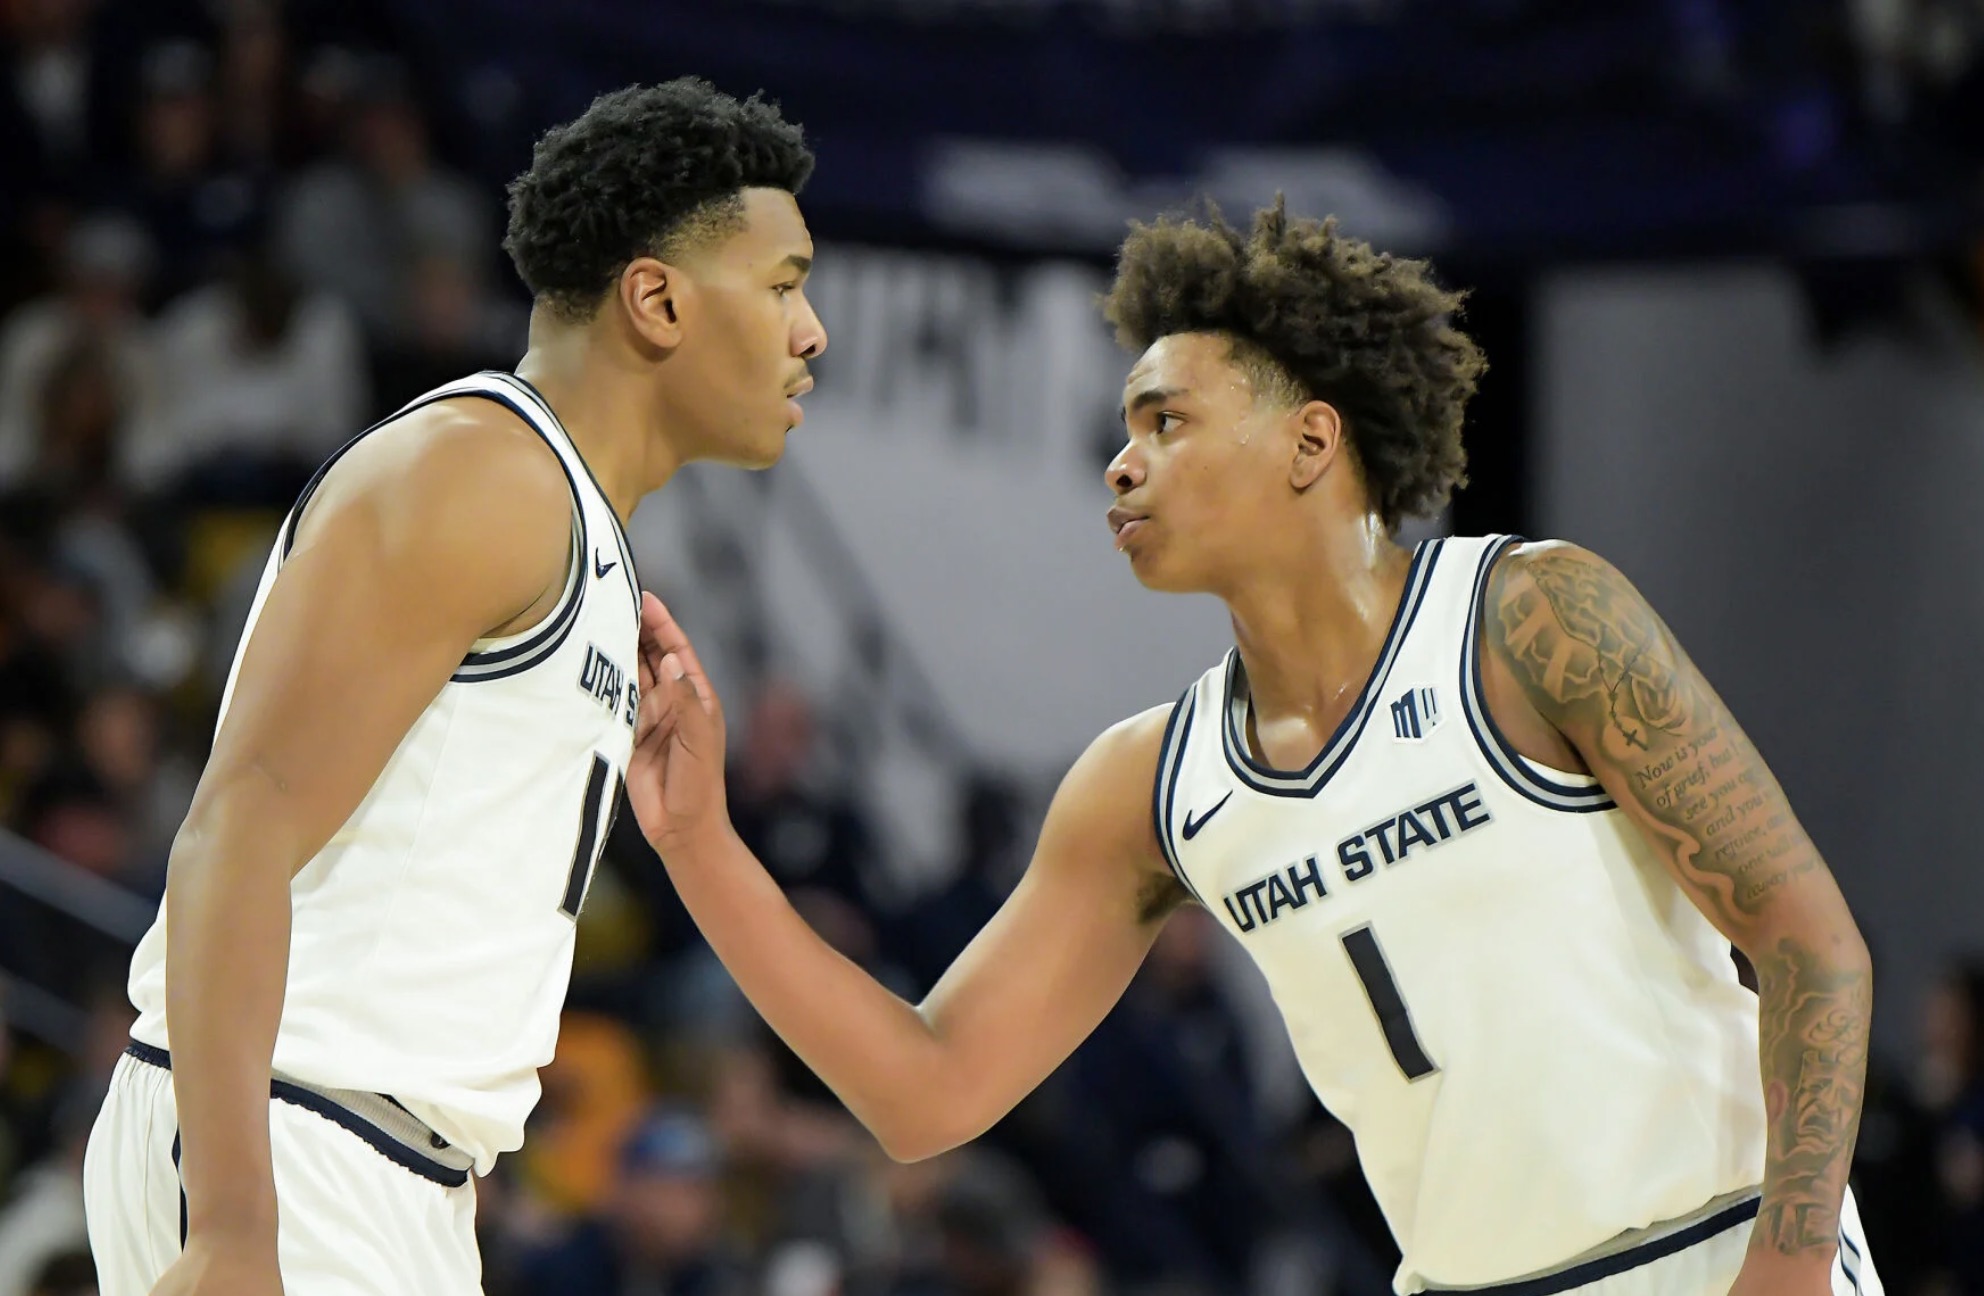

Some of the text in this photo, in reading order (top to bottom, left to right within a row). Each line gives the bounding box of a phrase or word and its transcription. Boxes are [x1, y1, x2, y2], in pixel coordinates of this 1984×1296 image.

[578, 643, 624, 717] UTAH
[1635, 757, 1674, 790] Now
[1674, 746, 1689, 762] is
[1656, 785, 1673, 810] of
[1706, 804, 1735, 837] and
[1222, 780, 1493, 934] UTAH STATE
[1338, 921, 1441, 1083] 1
